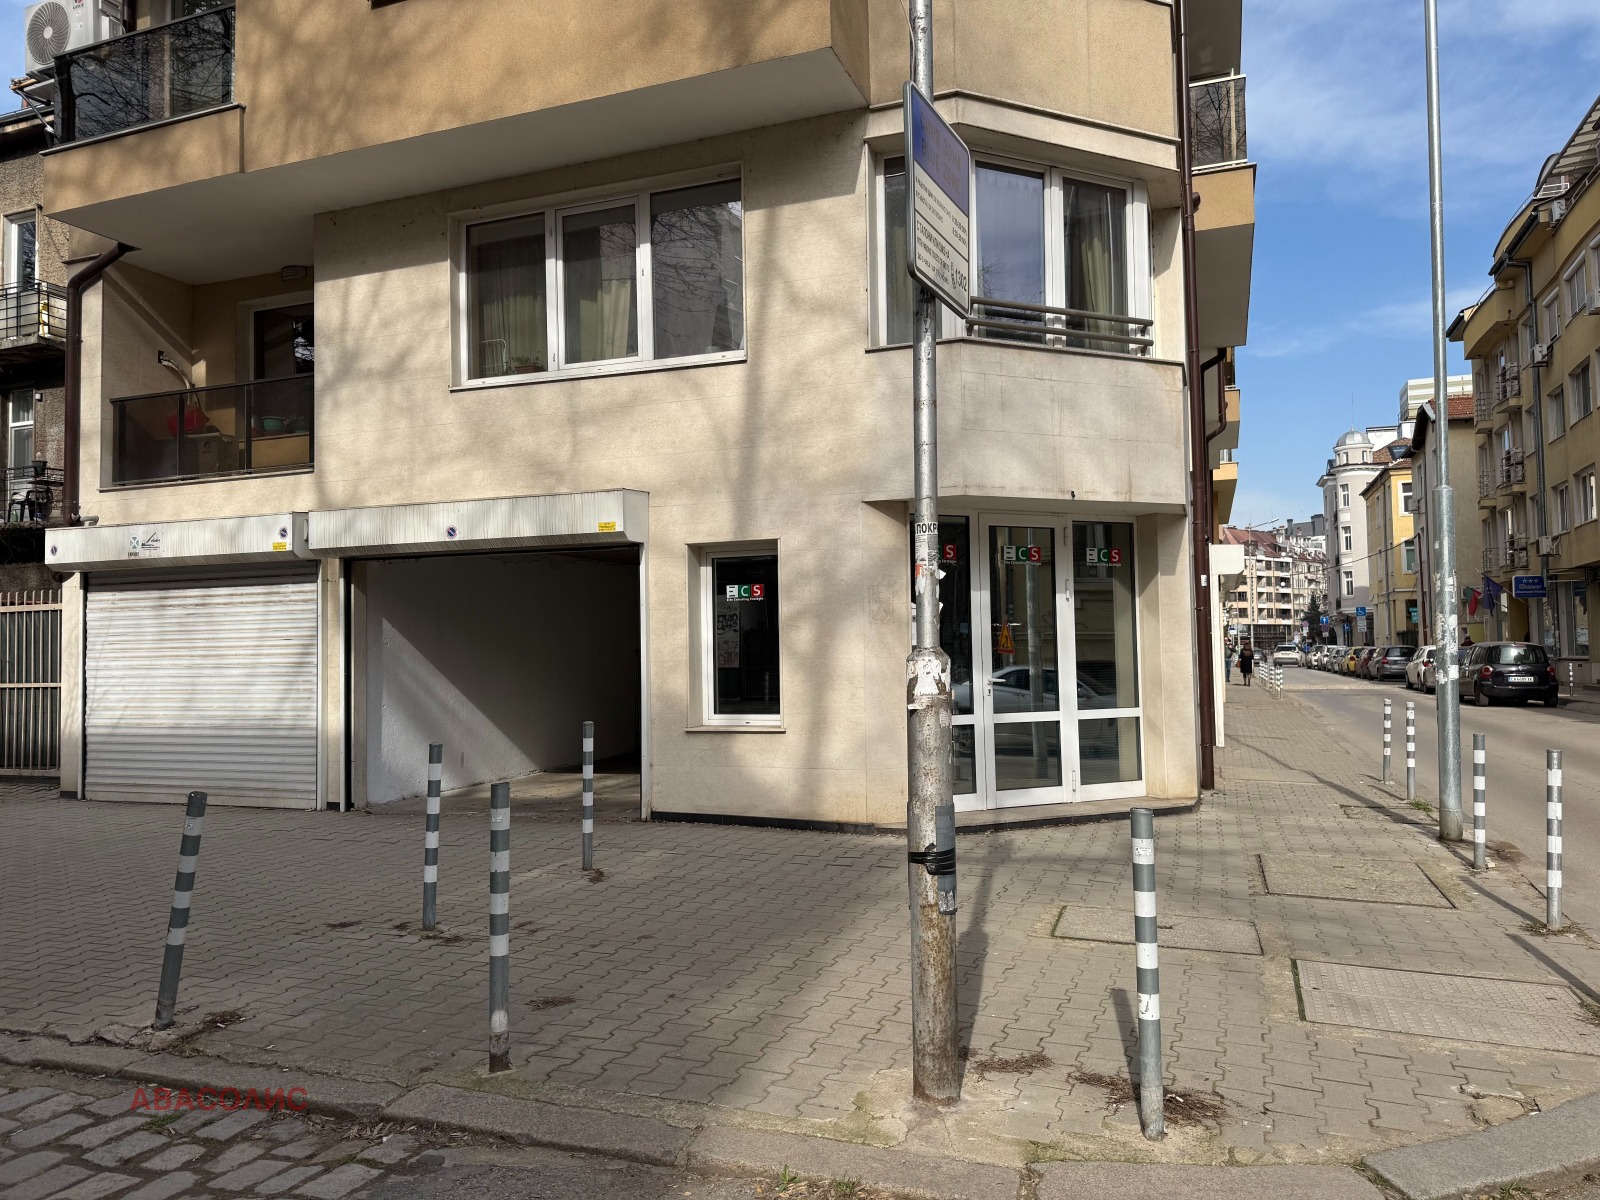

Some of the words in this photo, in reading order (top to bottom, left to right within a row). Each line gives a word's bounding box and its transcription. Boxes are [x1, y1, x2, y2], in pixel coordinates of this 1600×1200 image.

[920, 111, 940, 148] СИНЯ
[943, 137, 961, 171] ЗОНА
[922, 137, 940, 172] BLUE
[943, 162, 961, 195] ZONE
[955, 268, 967, 292] 1302
[1004, 546, 1041, 561] ECS
[1086, 548, 1121, 562] ECS
[726, 584, 763, 598] ECS
